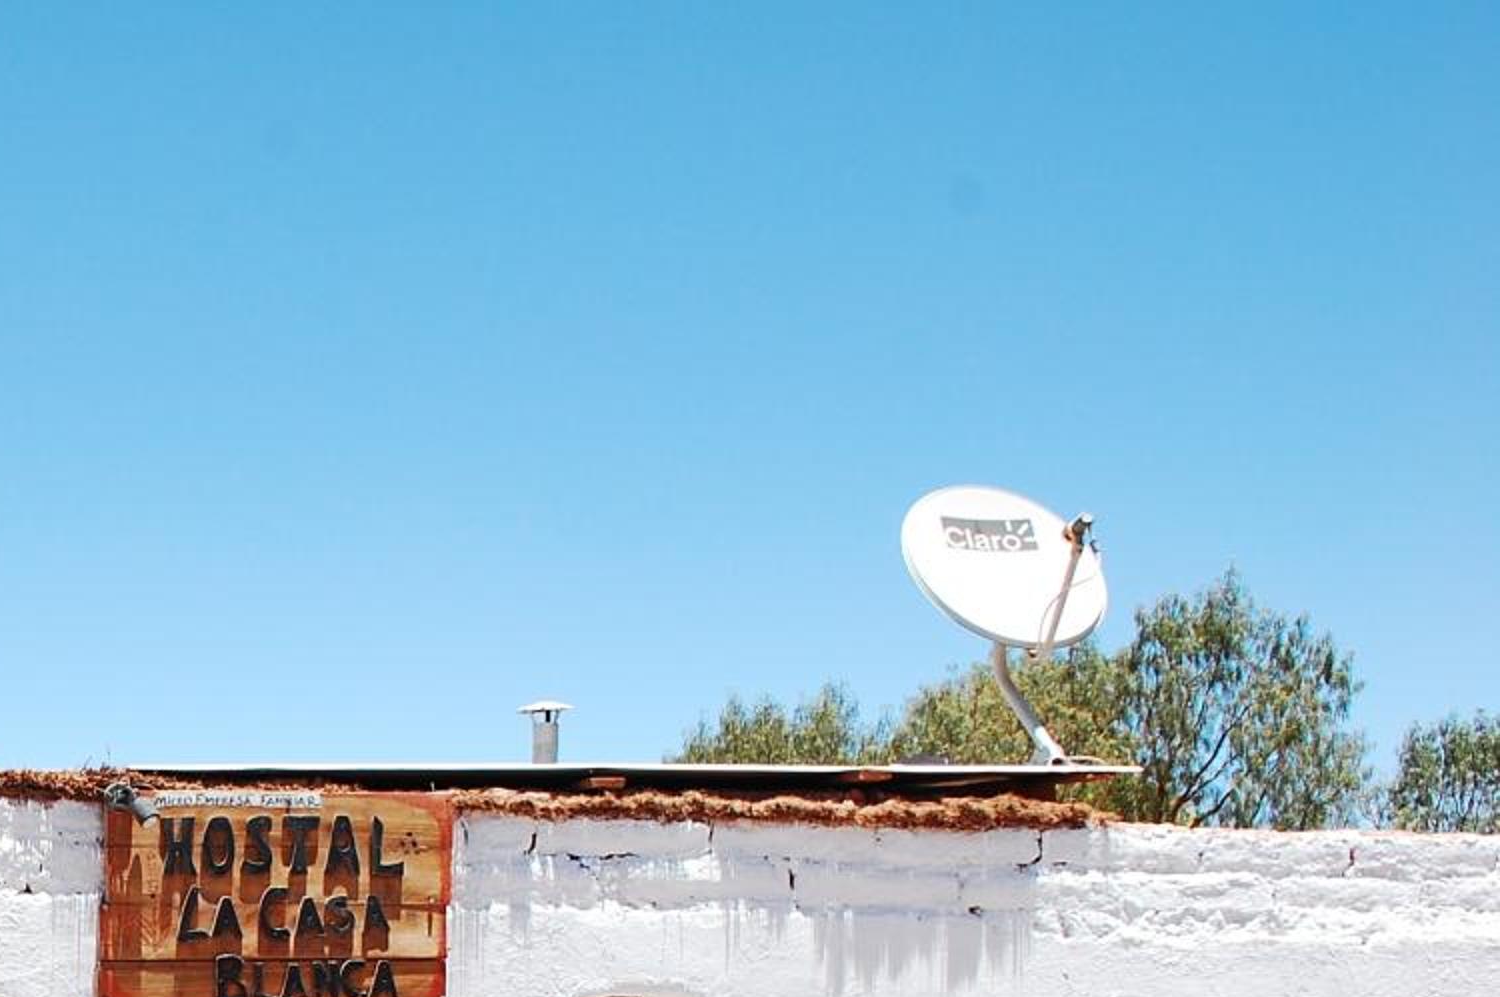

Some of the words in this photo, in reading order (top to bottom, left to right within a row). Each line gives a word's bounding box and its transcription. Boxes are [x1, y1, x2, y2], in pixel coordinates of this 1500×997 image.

[946, 526, 1022, 552] Claro
[160, 816, 405, 876] HOSTAL
[176, 884, 243, 943] LA
[258, 886, 390, 941] CASA
